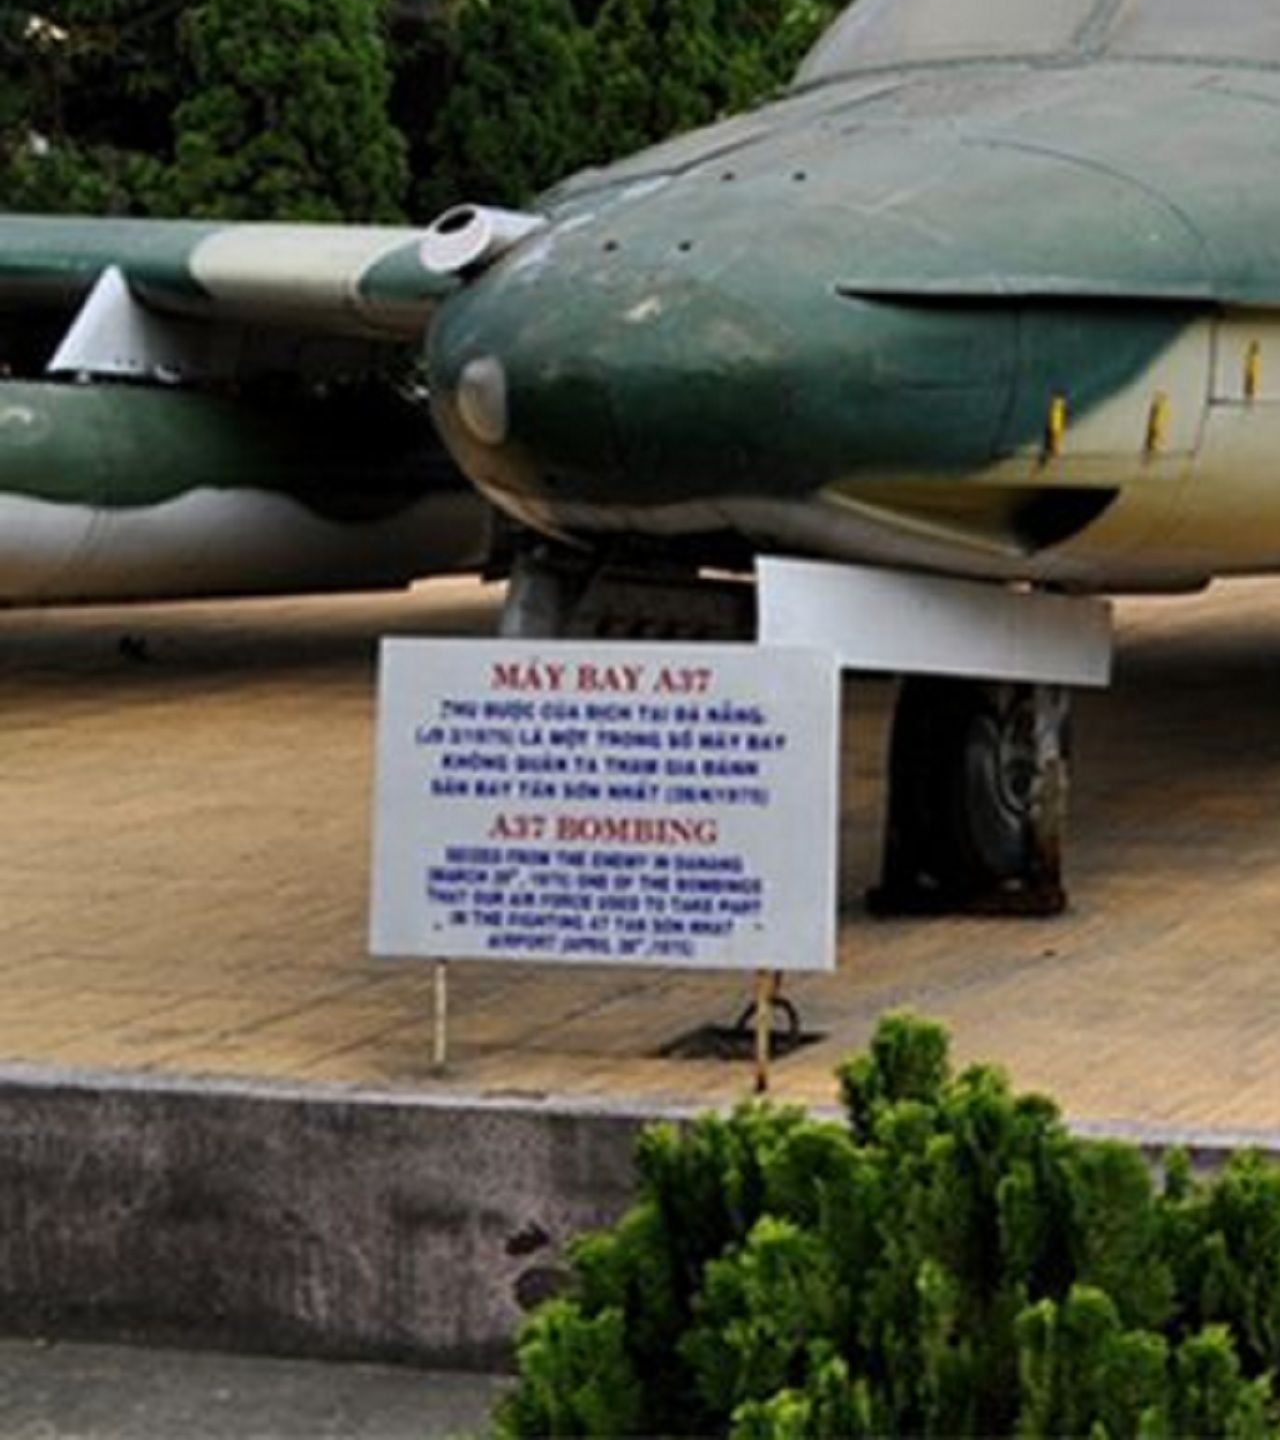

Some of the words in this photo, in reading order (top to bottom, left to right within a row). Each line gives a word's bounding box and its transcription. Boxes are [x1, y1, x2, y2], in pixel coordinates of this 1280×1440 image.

[489, 656, 565, 691] MÁY
[576, 664, 645, 692] BAY
[653, 666, 711, 692] A37
[488, 813, 547, 841] A37
[555, 816, 718, 844] BOMBING
